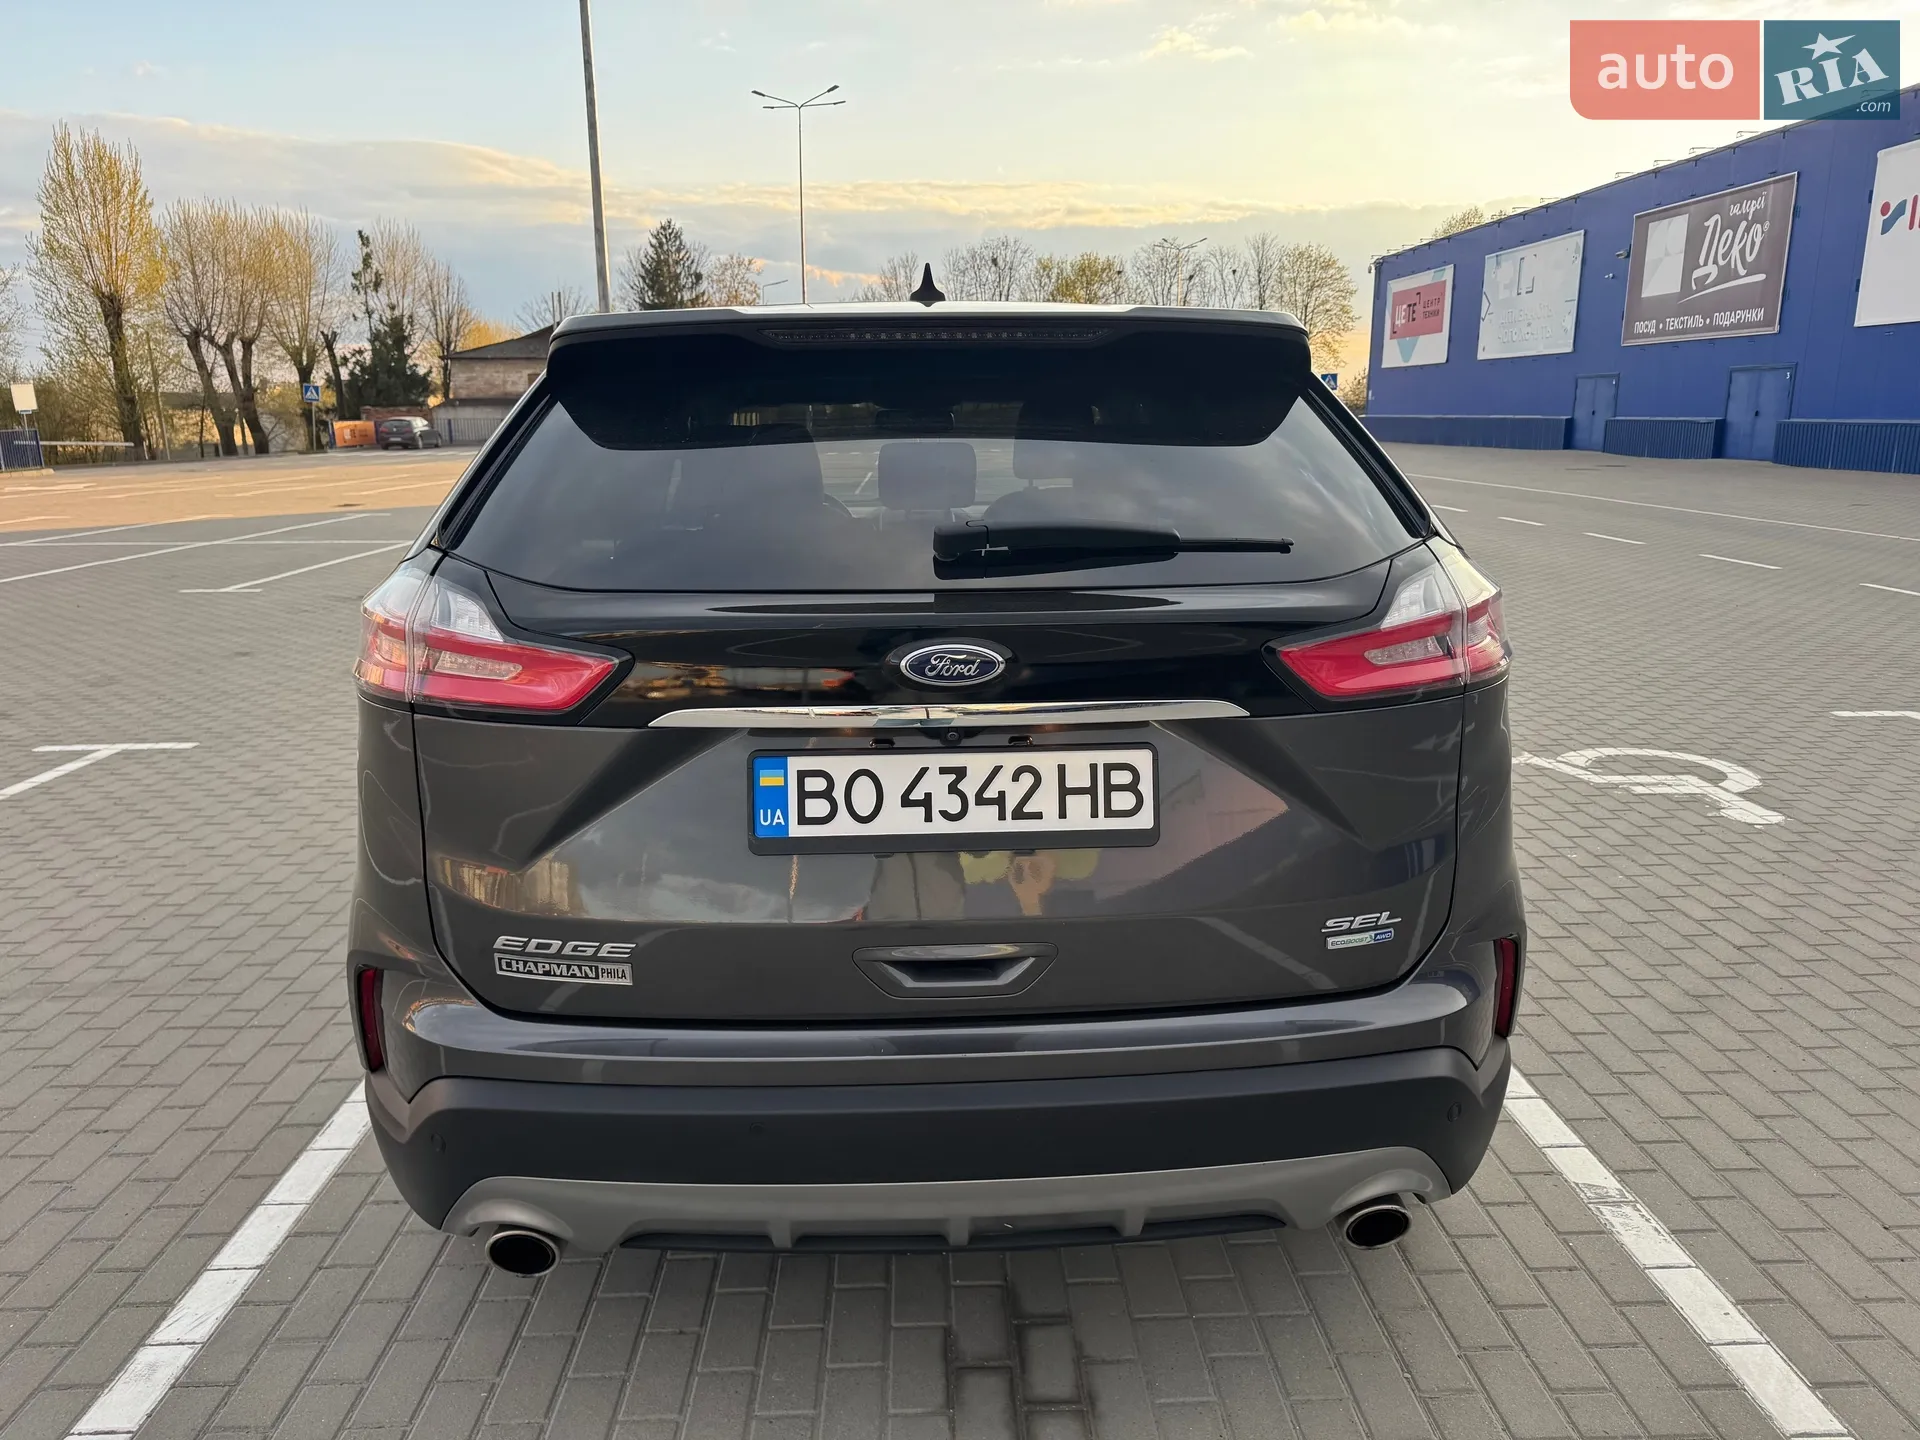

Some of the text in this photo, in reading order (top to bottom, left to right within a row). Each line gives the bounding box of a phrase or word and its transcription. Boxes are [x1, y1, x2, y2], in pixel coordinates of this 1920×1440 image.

[1691, 213, 1765, 291] Деко
[1633, 307, 1765, 334] ПОСУД ТЕКСТИЛЬ ПОДАРУНКИ
[925, 653, 981, 677] Ford
[900, 764, 1043, 823] 4342
[759, 809, 785, 826] UA
[1321, 911, 1402, 932] SEL
[492, 935, 637, 958] EDGE
[1375, 932, 1392, 940] AWD
[500, 958, 627, 980] CHAPMAN PHILA
